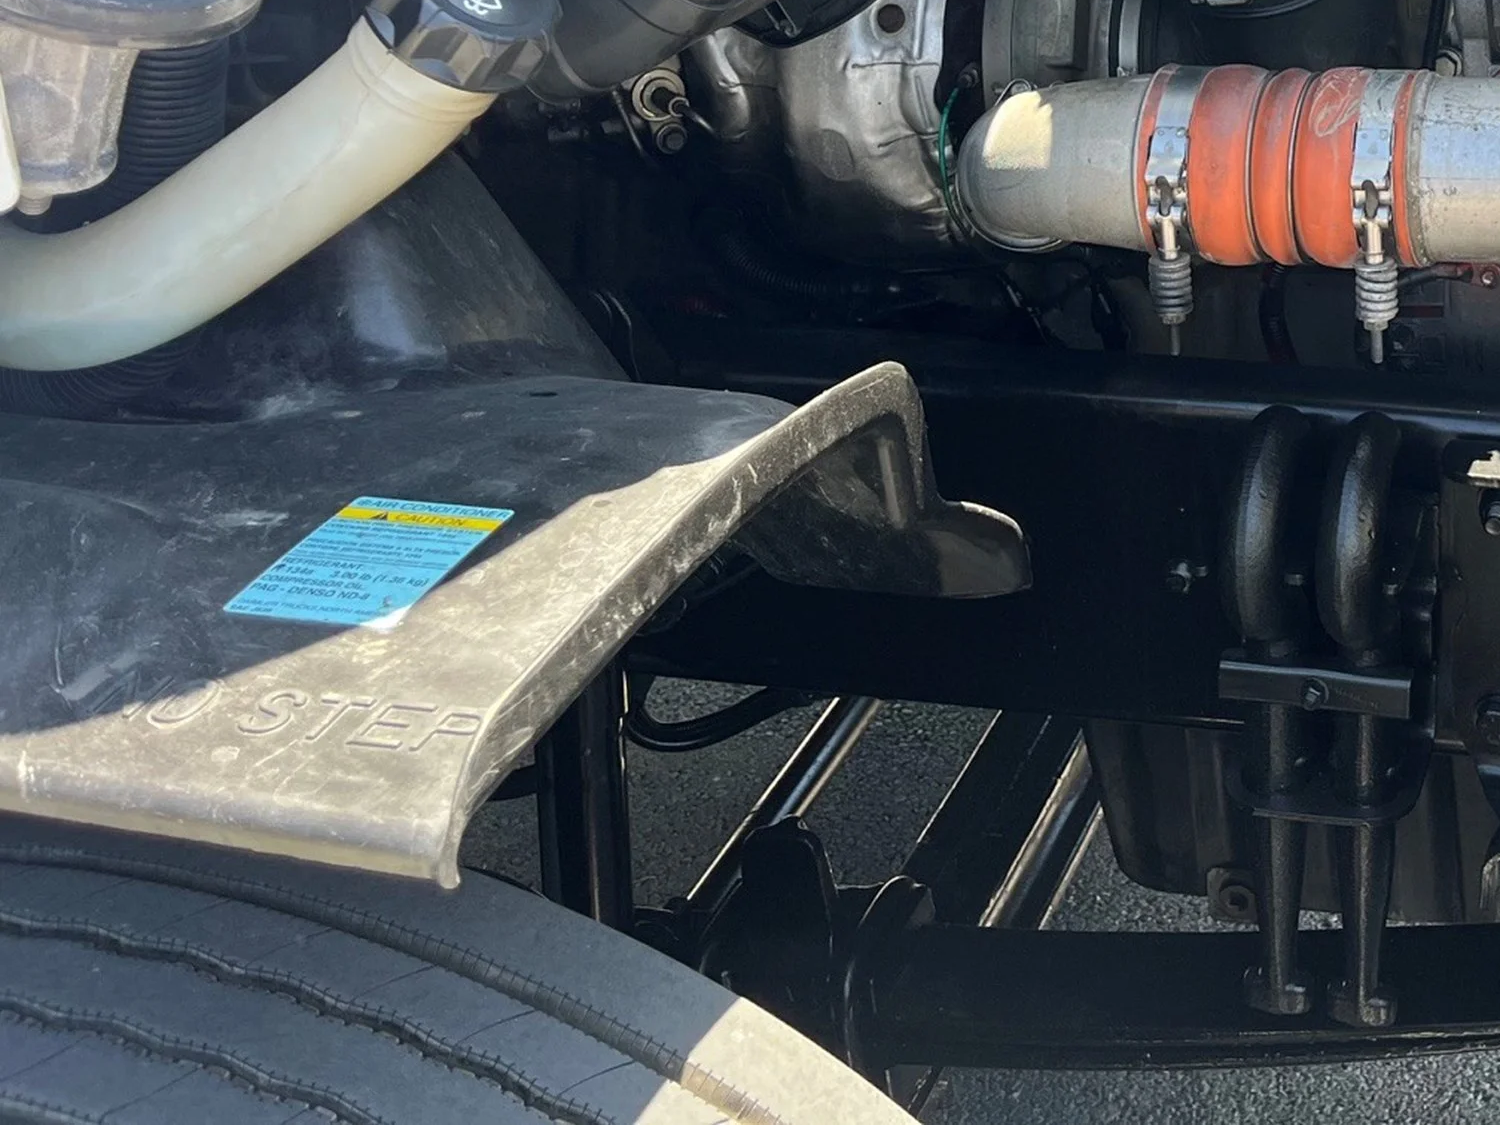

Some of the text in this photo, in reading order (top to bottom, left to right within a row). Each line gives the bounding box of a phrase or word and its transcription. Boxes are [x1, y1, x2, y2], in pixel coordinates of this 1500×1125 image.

[372, 498, 508, 518] AIR CONDITIONER
[394, 512, 465, 526] CAUTION
[261, 574, 343, 588] COMPRESSOR
[329, 570, 359, 580] 3.00
[359, 571, 372, 580] lb
[248, 582, 279, 592] PAG
[287, 585, 337, 598] DENSO
[84, 674, 490, 753] NO STEP
